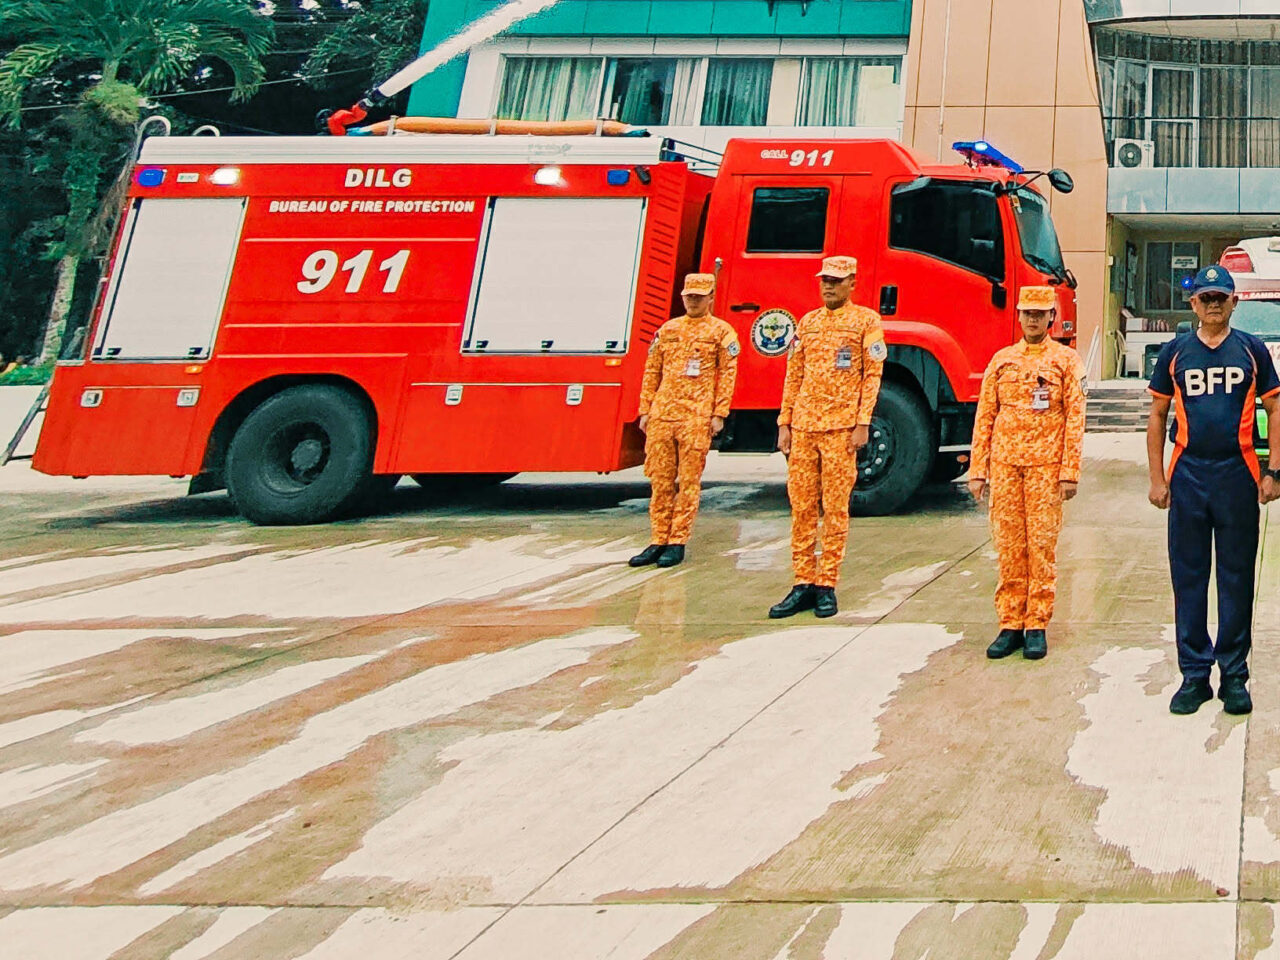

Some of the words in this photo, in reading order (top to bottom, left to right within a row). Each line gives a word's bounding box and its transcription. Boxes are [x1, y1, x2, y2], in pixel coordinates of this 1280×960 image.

[760, 149, 789, 159] CALL
[789, 149, 834, 167] 911
[344, 168, 412, 188] DILG
[269, 200, 327, 213] BUREAU
[329, 200, 349, 213] OF
[350, 200, 383, 213] FIRE
[385, 200, 475, 213] PROTECTION
[296, 249, 411, 294] 911
[1184, 366, 1245, 397] BFP
